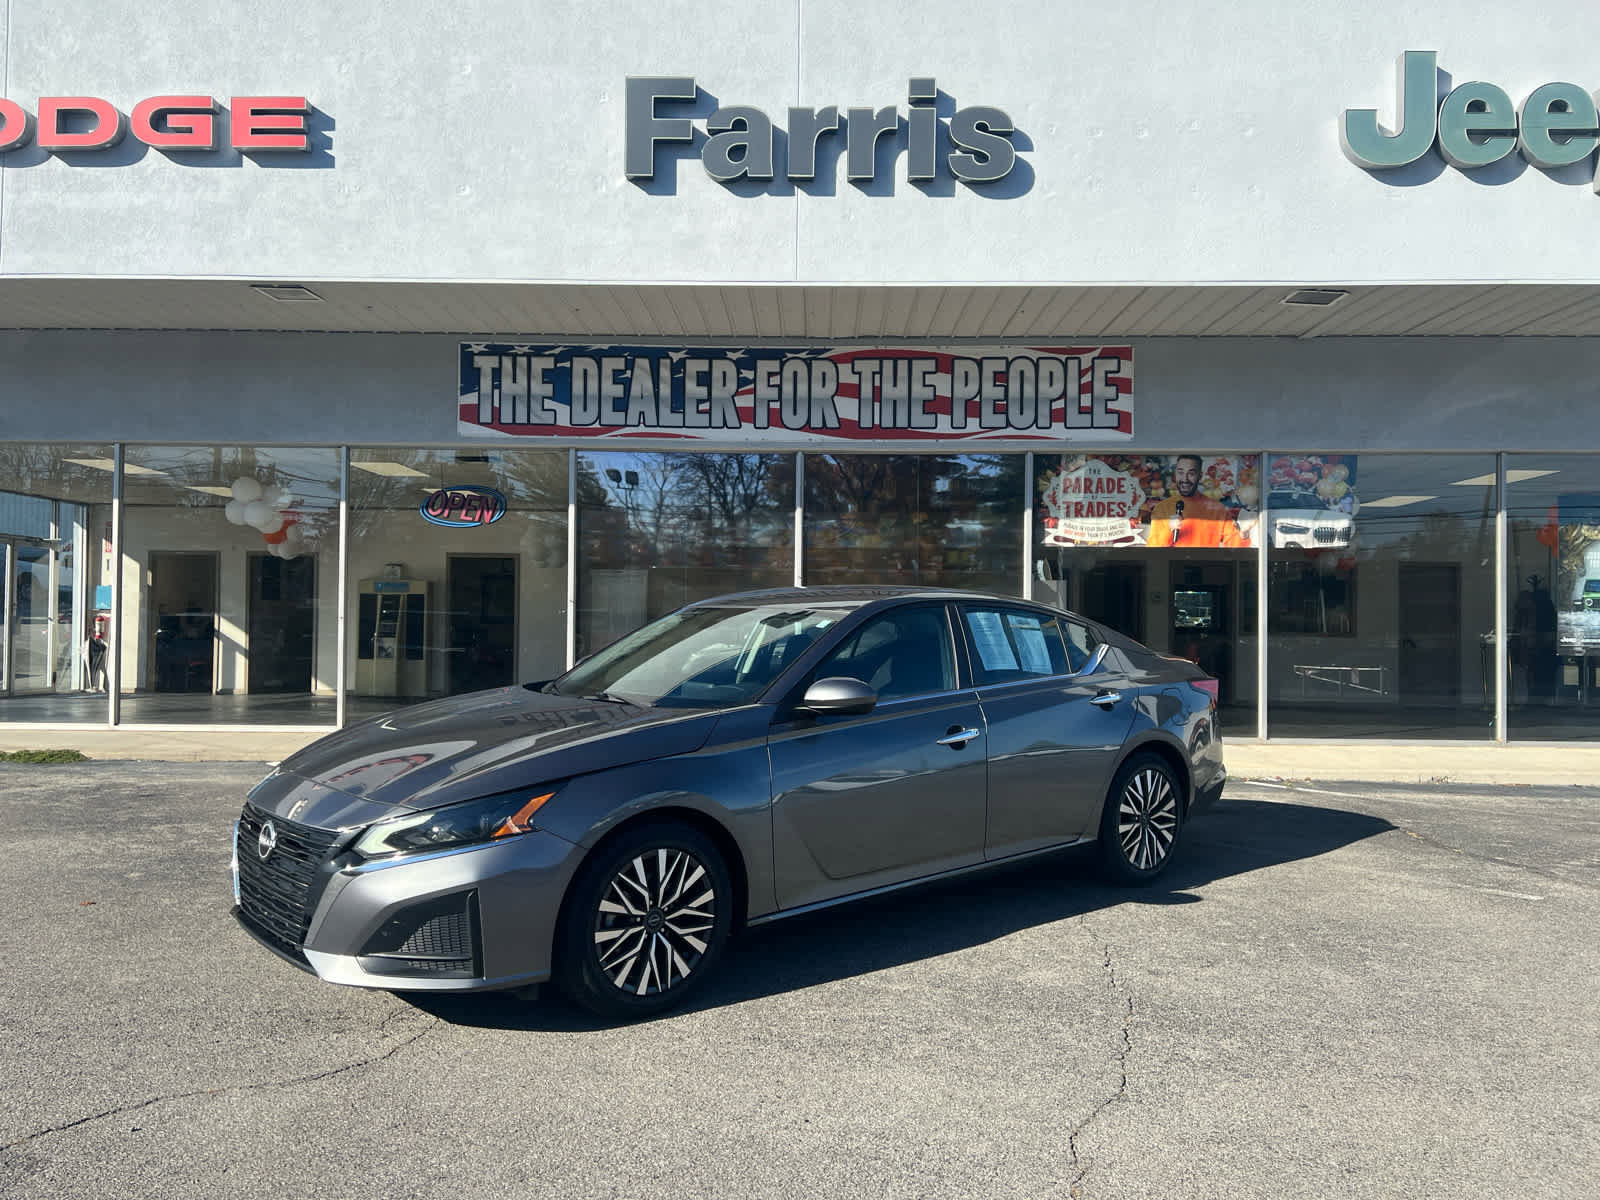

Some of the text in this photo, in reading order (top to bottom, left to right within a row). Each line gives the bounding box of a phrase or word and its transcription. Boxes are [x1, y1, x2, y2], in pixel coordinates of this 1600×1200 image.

[625, 76, 1016, 181] Farris
[1340, 50, 1600, 196] Jee
[473, 355, 1121, 430] THE DEALER FOR THE PEOPLE
[427, 489, 497, 524] OPEN
[1062, 501, 1127, 518] TRADES
[1063, 477, 1127, 494] PARADE
